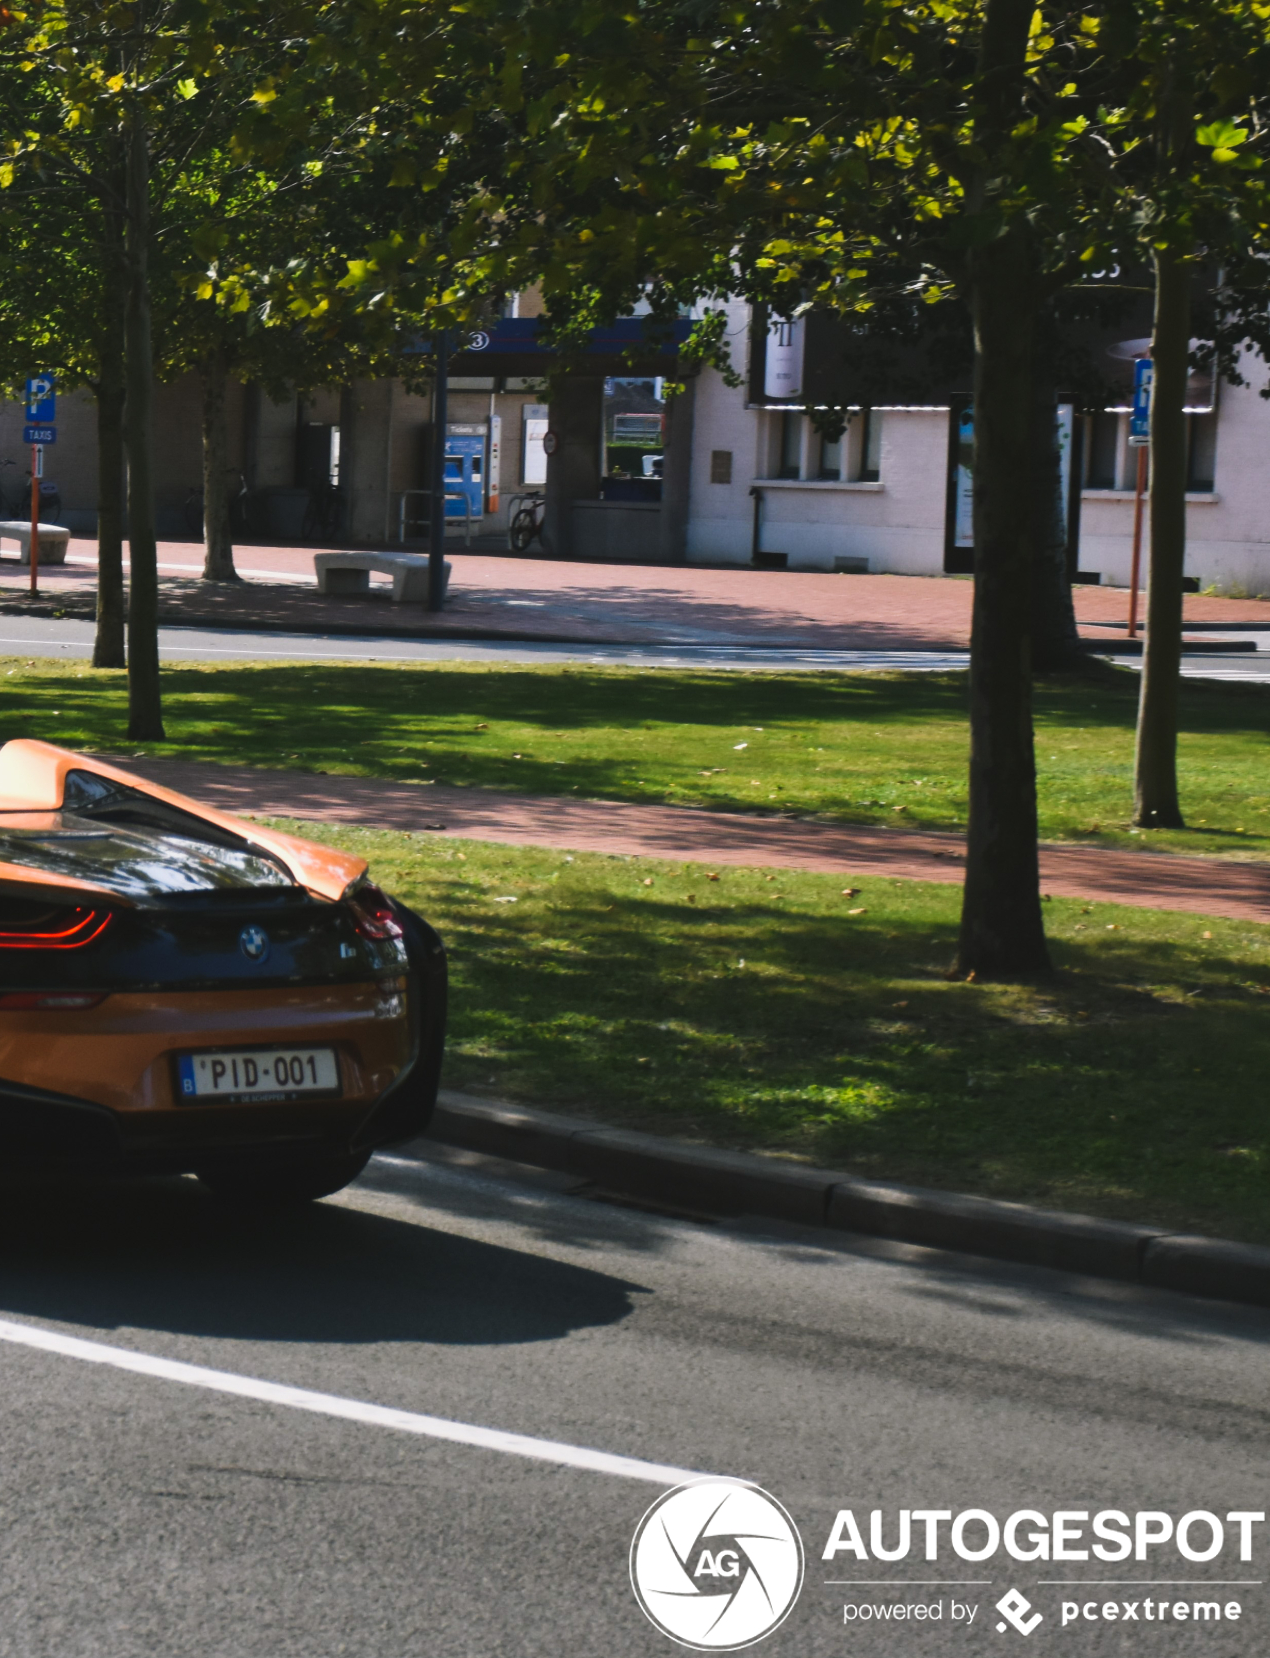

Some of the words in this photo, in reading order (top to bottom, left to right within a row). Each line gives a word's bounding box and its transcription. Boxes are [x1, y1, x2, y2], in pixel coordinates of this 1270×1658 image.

[471, 333, 484, 348] 3
[30, 378, 51, 414] P
[28, 429, 52, 441] TAXIS
[183, 1078, 193, 1092] B
